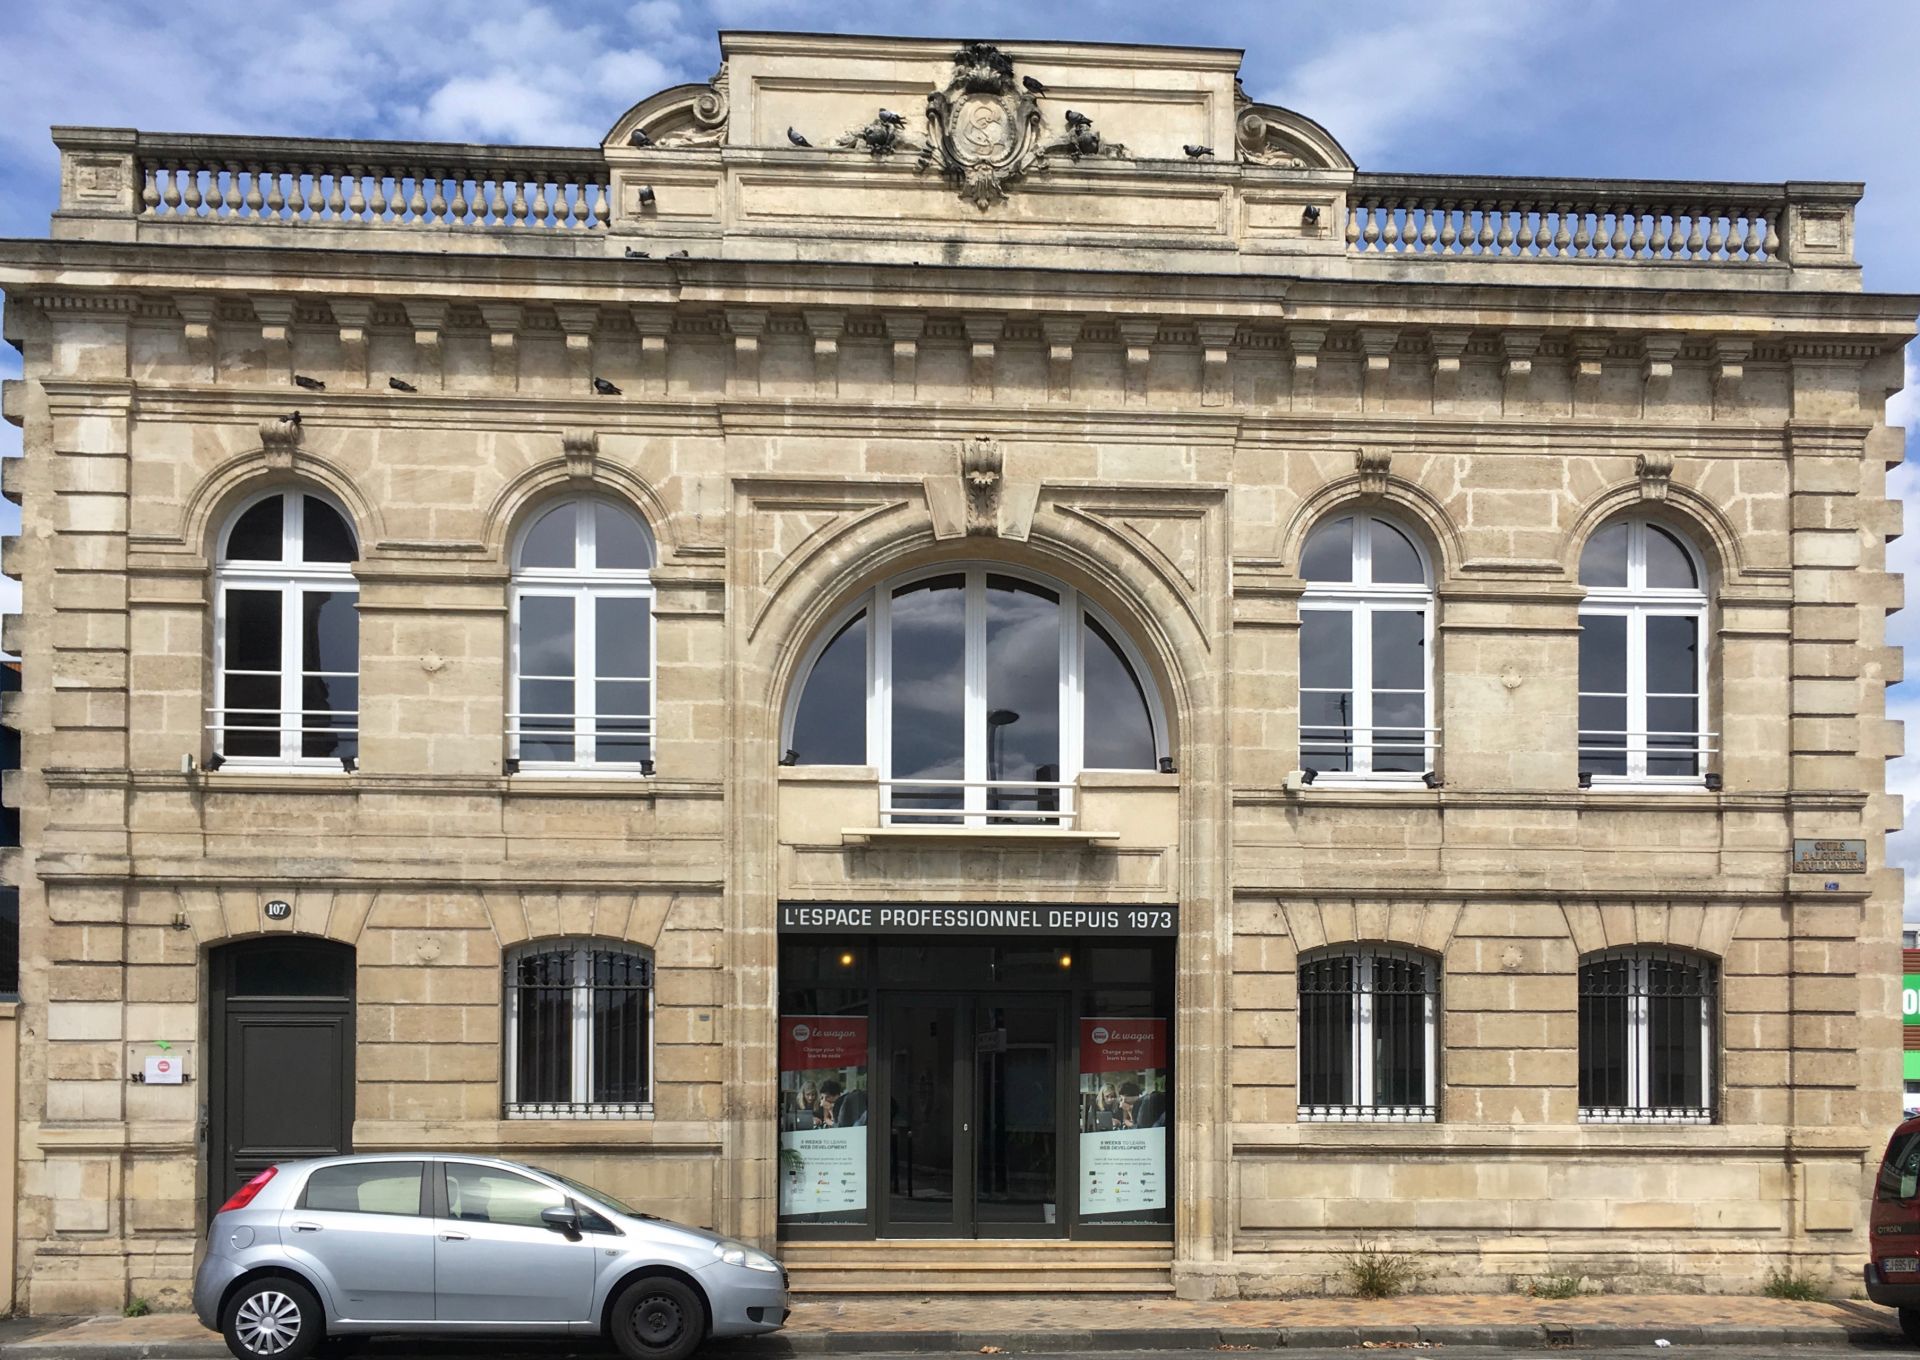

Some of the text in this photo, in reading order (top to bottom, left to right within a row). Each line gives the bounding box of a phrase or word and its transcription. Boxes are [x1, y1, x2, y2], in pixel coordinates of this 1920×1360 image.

[268, 904, 286, 915] 107
[785, 908, 1172, 929] L'ESPACE PROFESSIONNEL DEPUIS 1973
[823, 1030, 857, 1040] wagon
[1111, 1030, 1154, 1042] le wagon
